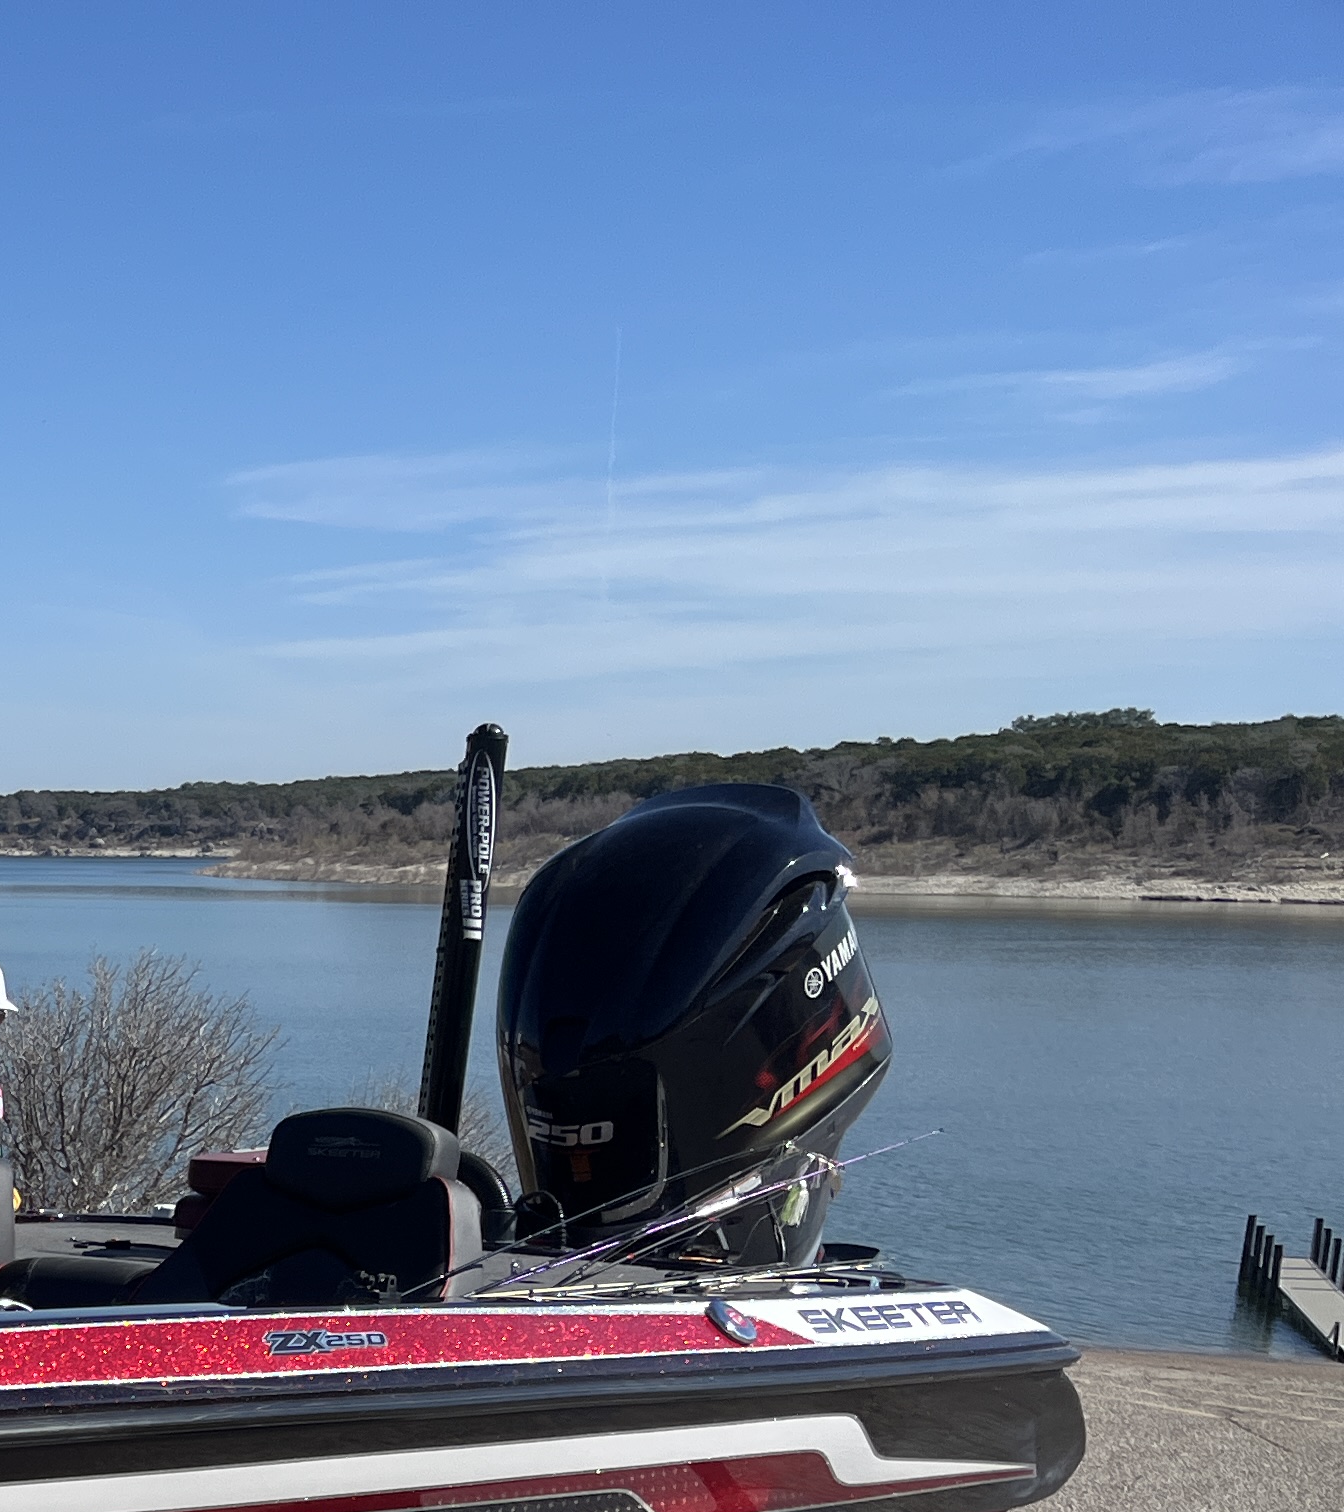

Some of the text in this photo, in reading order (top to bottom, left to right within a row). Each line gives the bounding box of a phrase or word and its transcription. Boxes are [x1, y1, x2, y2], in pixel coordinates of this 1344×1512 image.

[476, 766, 491, 874] POWER-POLE
[470, 880, 482, 918] PRO
[820, 928, 859, 982] YAMA
[527, 1118, 614, 1147] 250
[797, 1300, 983, 1334] SKEETER
[264, 1329, 387, 1355] ZX250
